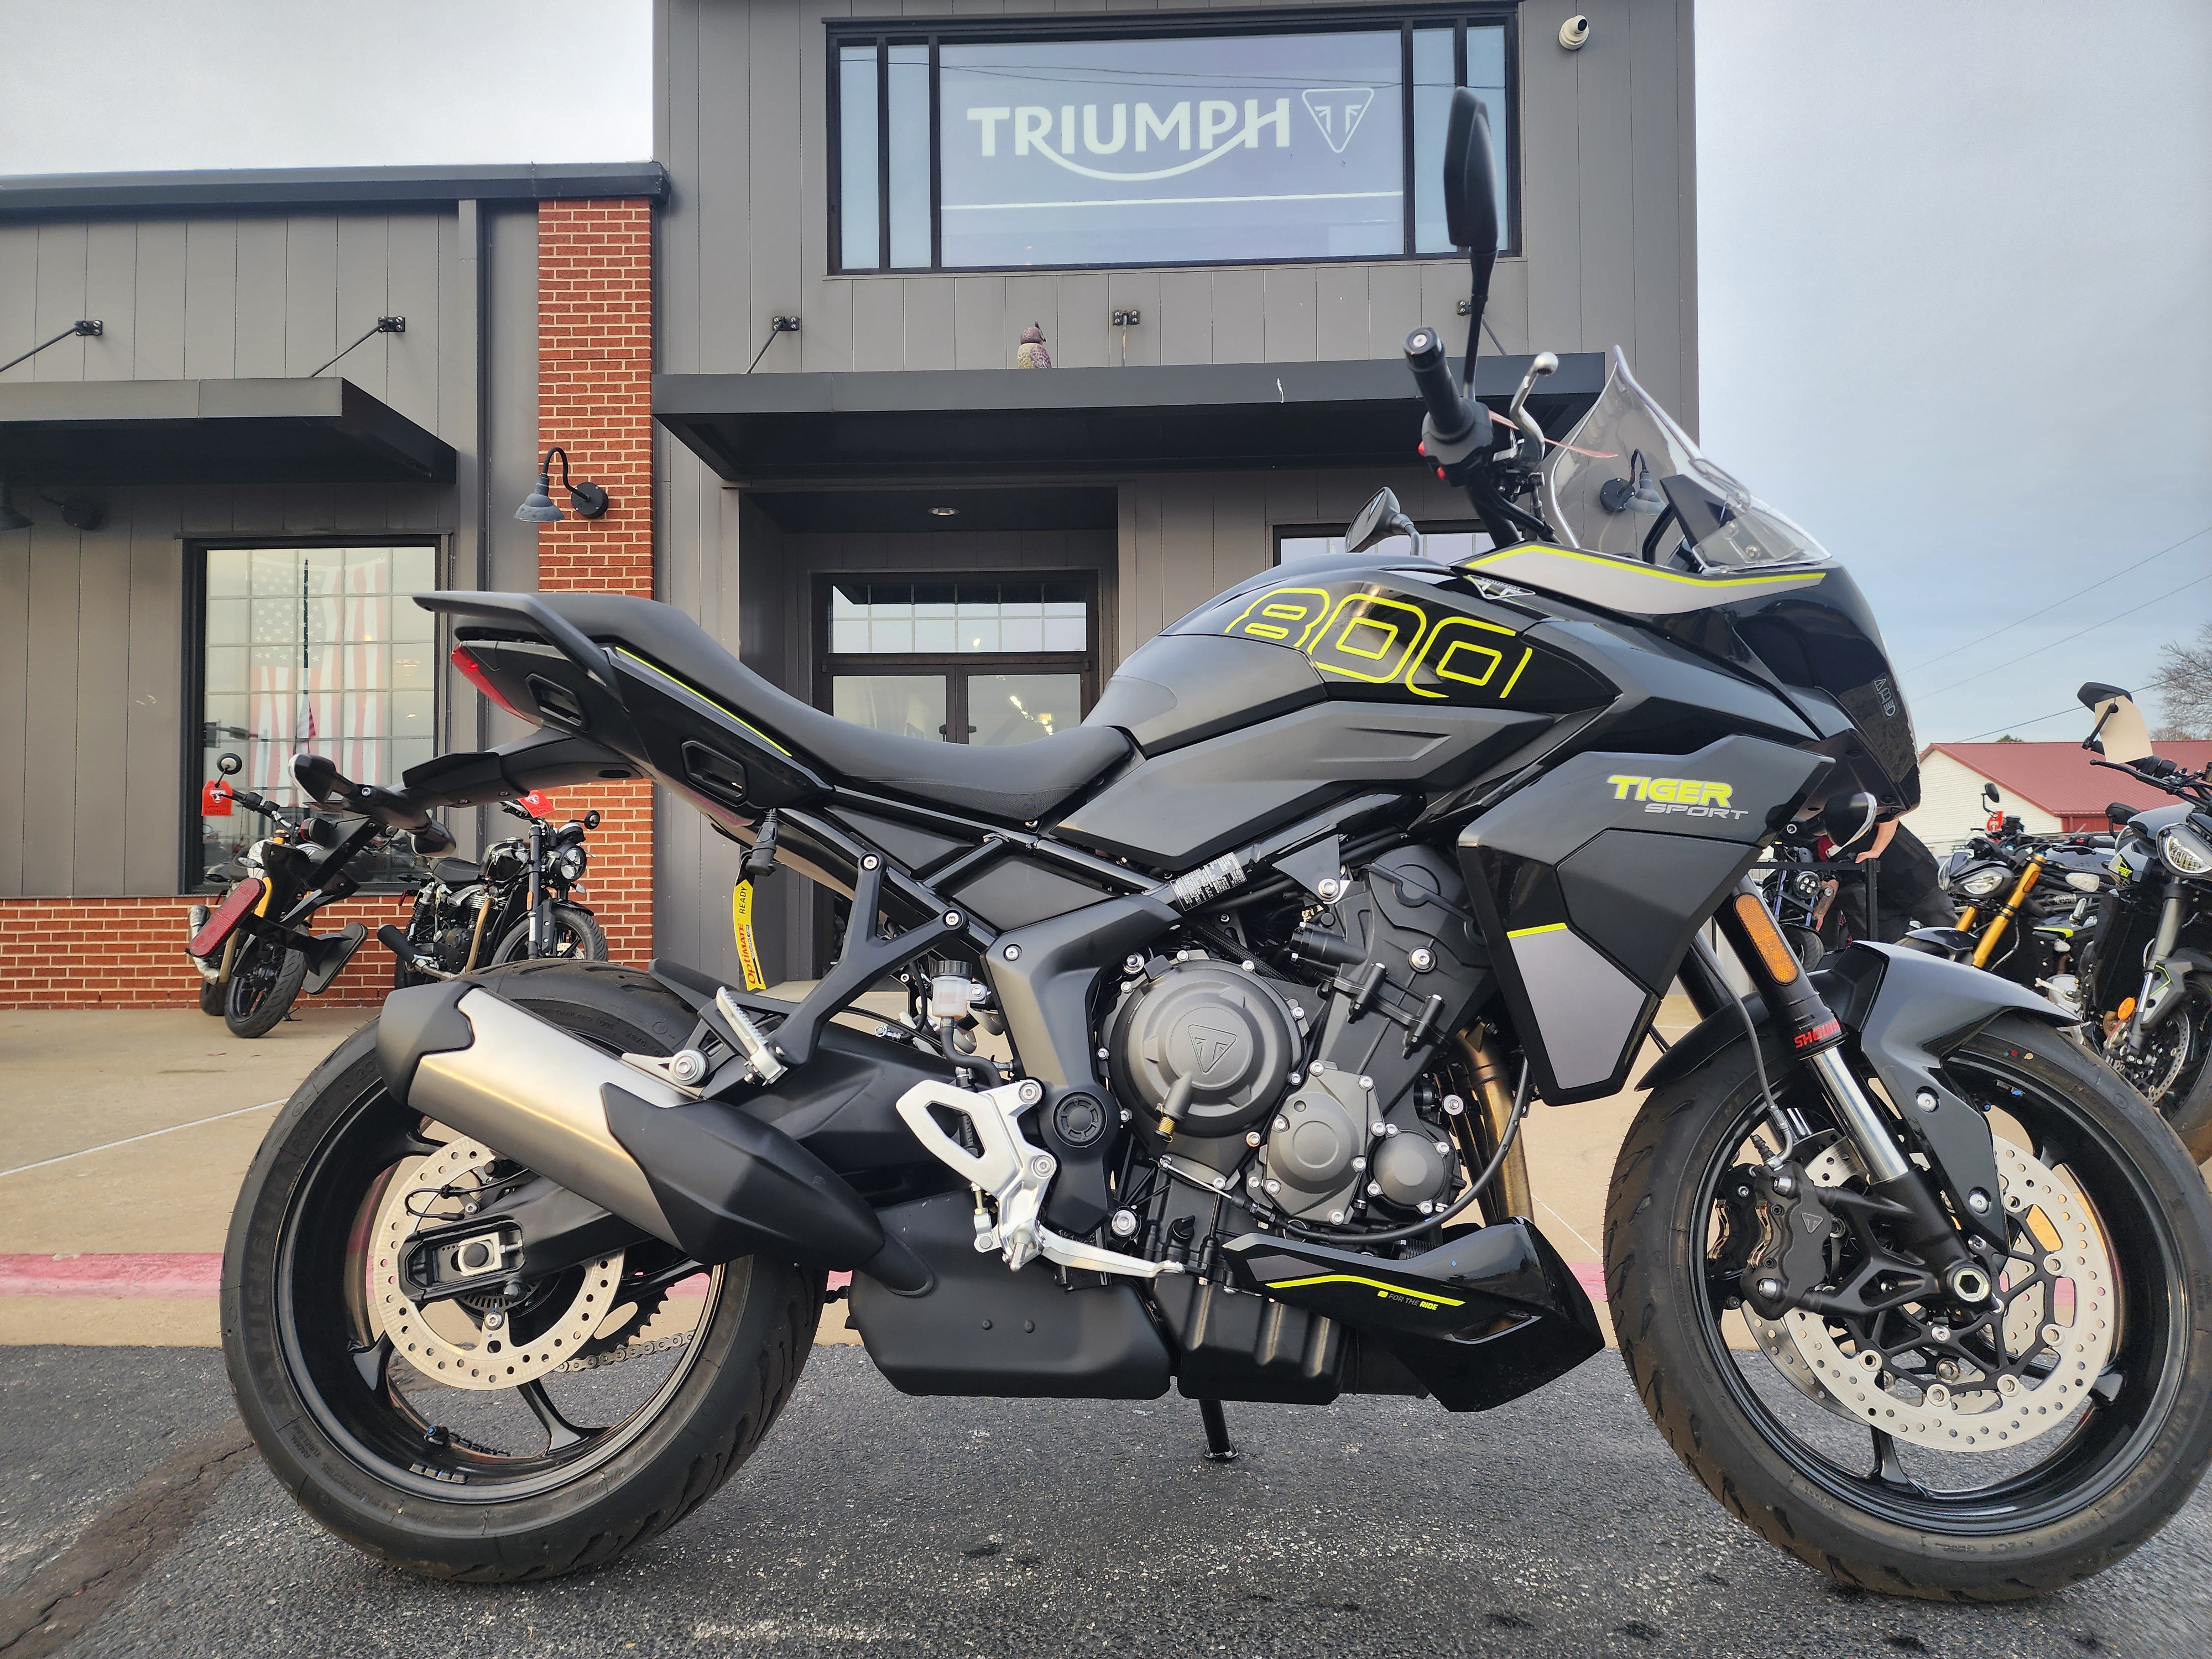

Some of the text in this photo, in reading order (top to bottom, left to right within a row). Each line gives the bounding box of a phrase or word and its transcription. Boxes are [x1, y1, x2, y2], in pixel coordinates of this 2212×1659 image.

[967, 97, 1290, 181] TRIUMPH
[1224, 587, 1532, 698] 800
[1606, 774, 1733, 808] TIGER
[1644, 804, 1749, 820] SPORT
[739, 885, 747, 914] READY
[1388, 1293, 1438, 1310] FOR THE RIDE
